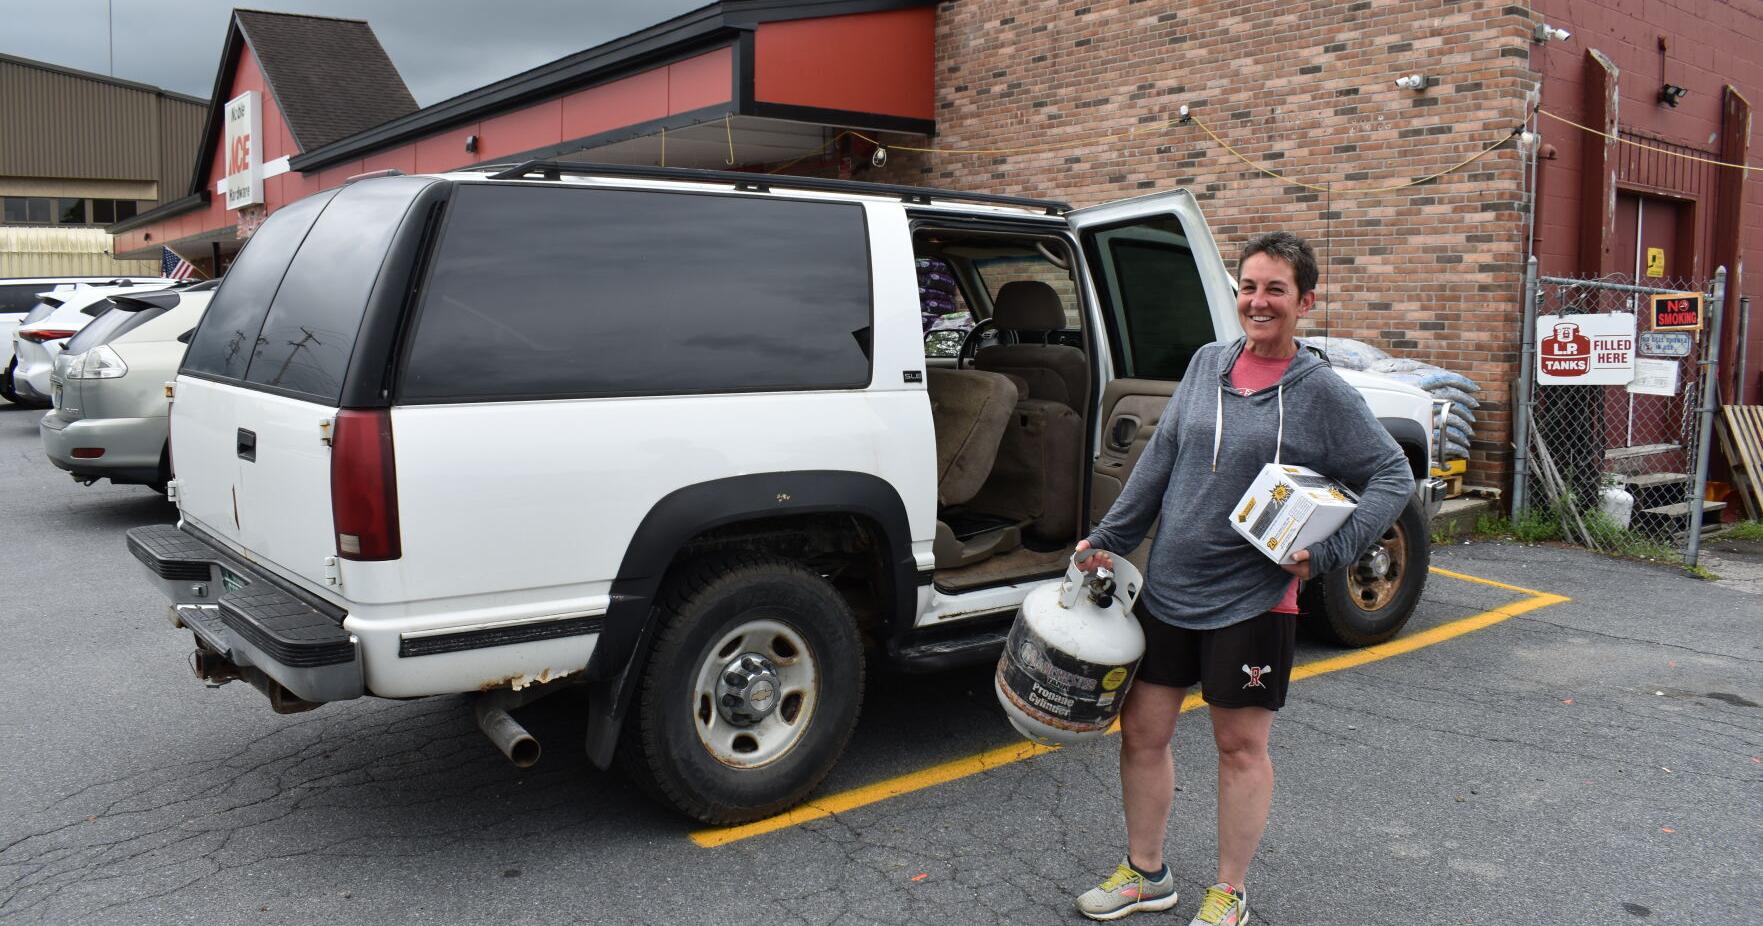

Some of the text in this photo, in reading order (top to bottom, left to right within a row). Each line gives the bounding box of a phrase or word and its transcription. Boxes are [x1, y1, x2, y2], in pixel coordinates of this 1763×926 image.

[228, 134, 250, 177] ACE
[1658, 311, 1697, 325] SMOKING
[1593, 339, 1632, 351] FILLED
[1545, 361, 1586, 370] TANKS
[1597, 352, 1628, 364] HERE
[1249, 666, 1260, 687] R
[1032, 681, 1075, 707] Propane
[1028, 692, 1071, 716] Cylinder
